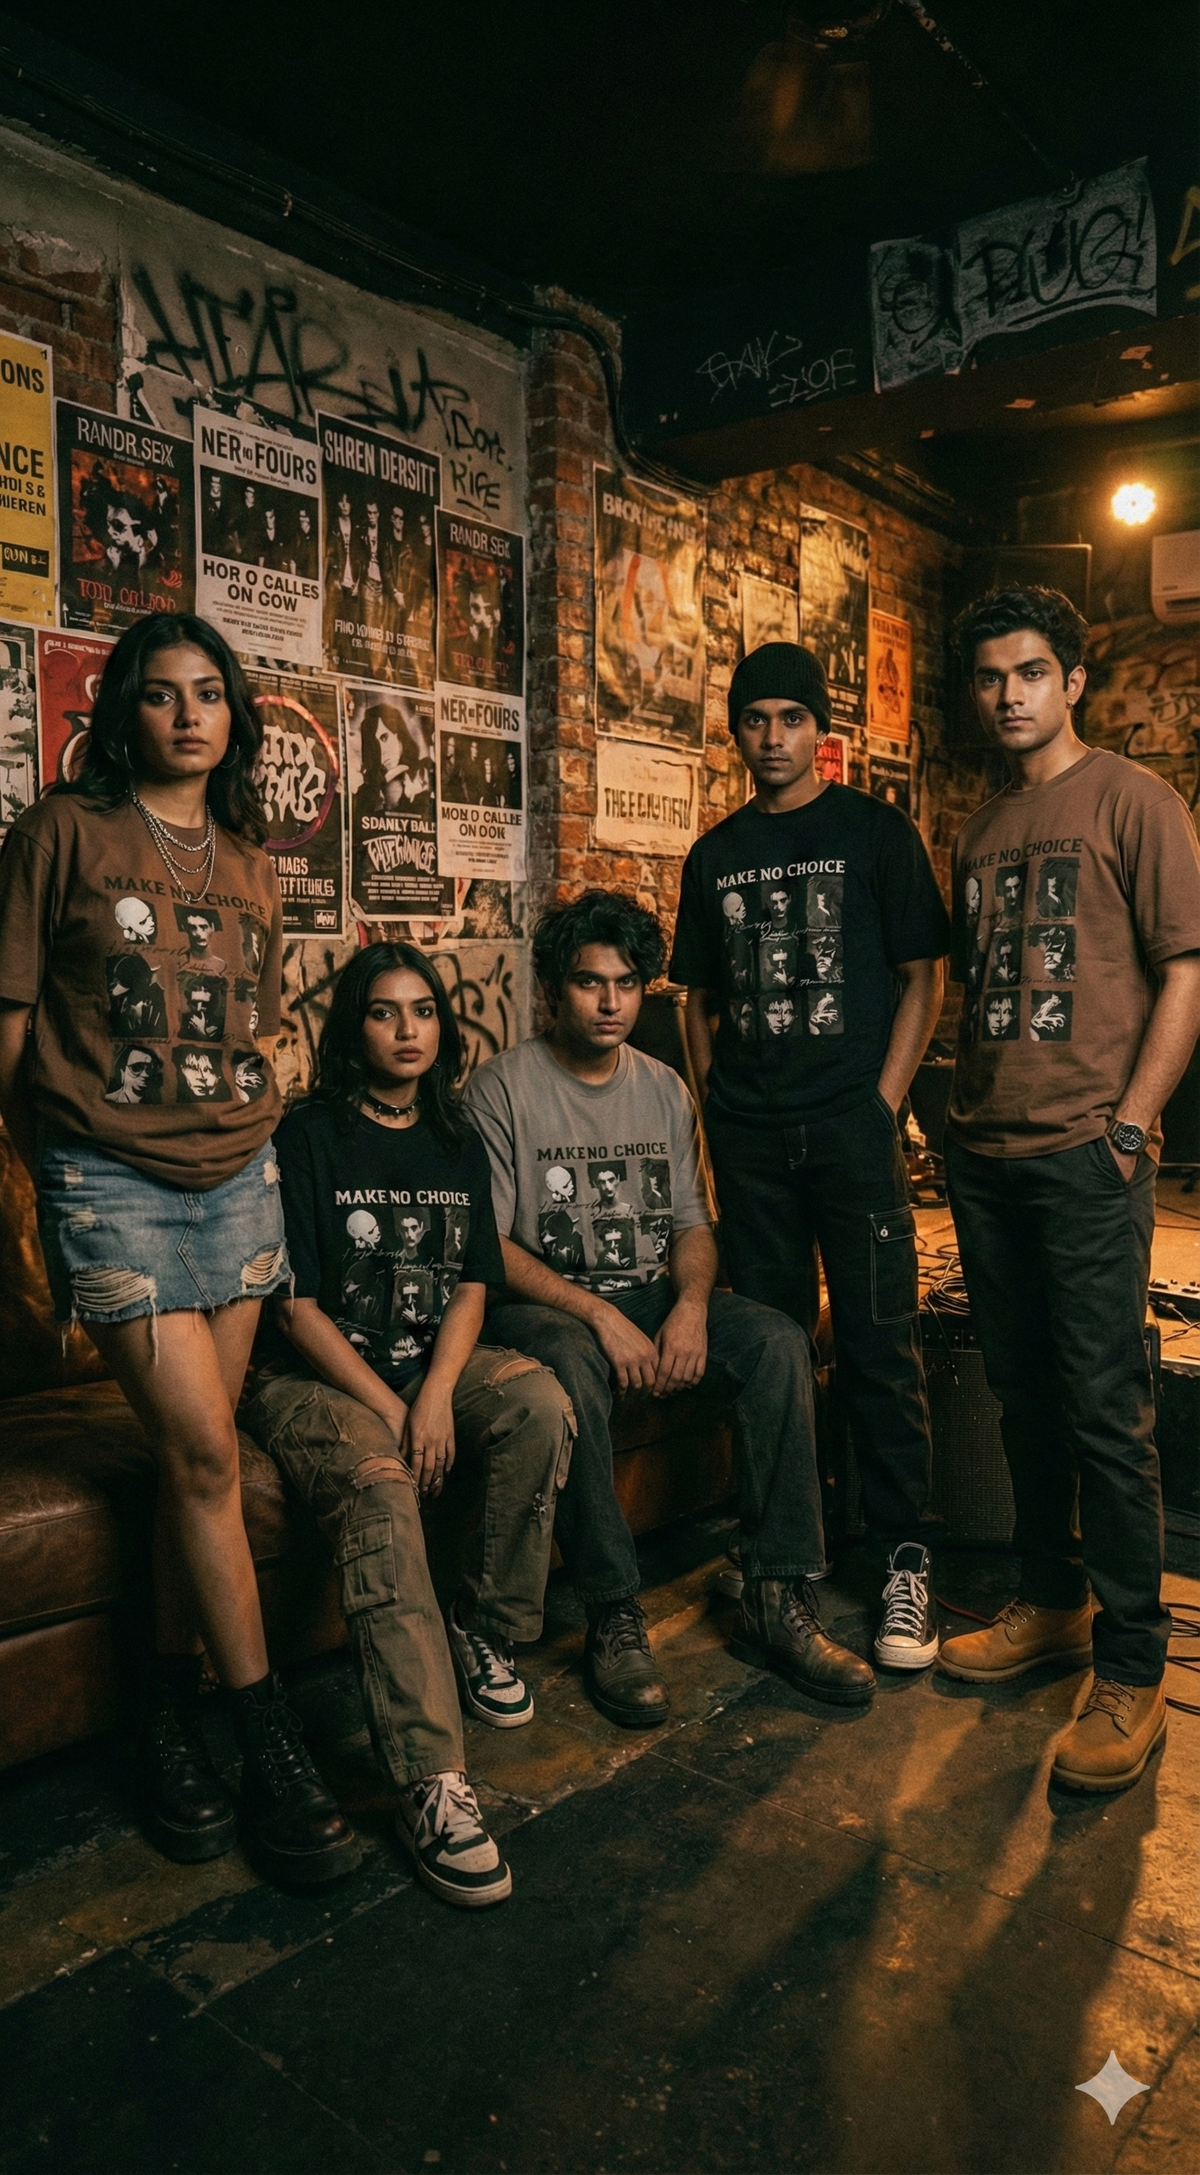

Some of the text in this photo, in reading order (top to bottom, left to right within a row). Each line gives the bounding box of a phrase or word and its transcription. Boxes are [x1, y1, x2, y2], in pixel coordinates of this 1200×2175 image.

[201, 425, 242, 464] NER
[255, 442, 317, 485] FOURS
[324, 429, 376, 476] SHREN
[380, 448, 436, 497] DERSITT
[203, 559, 240, 582] HOR
[263, 573, 319, 600] CALLES
[227, 583, 252, 604] ON
[475, 703, 520, 732] FOURS
[361, 815, 409, 832] SDANLY
[459, 823, 477, 837] ON
[998, 848, 1021, 864] NO
[1024, 838, 1083, 859] CHOICE
[759, 866, 783, 881] NO
[786, 860, 846, 877] CHOICE
[103, 875, 166, 895] MAKE
[202, 893, 266, 918] CHOICE
[536, 1142, 668, 1161] MAKE NO CHOICE
[335, 1189, 471, 1206] MAKE NO CHOICE
